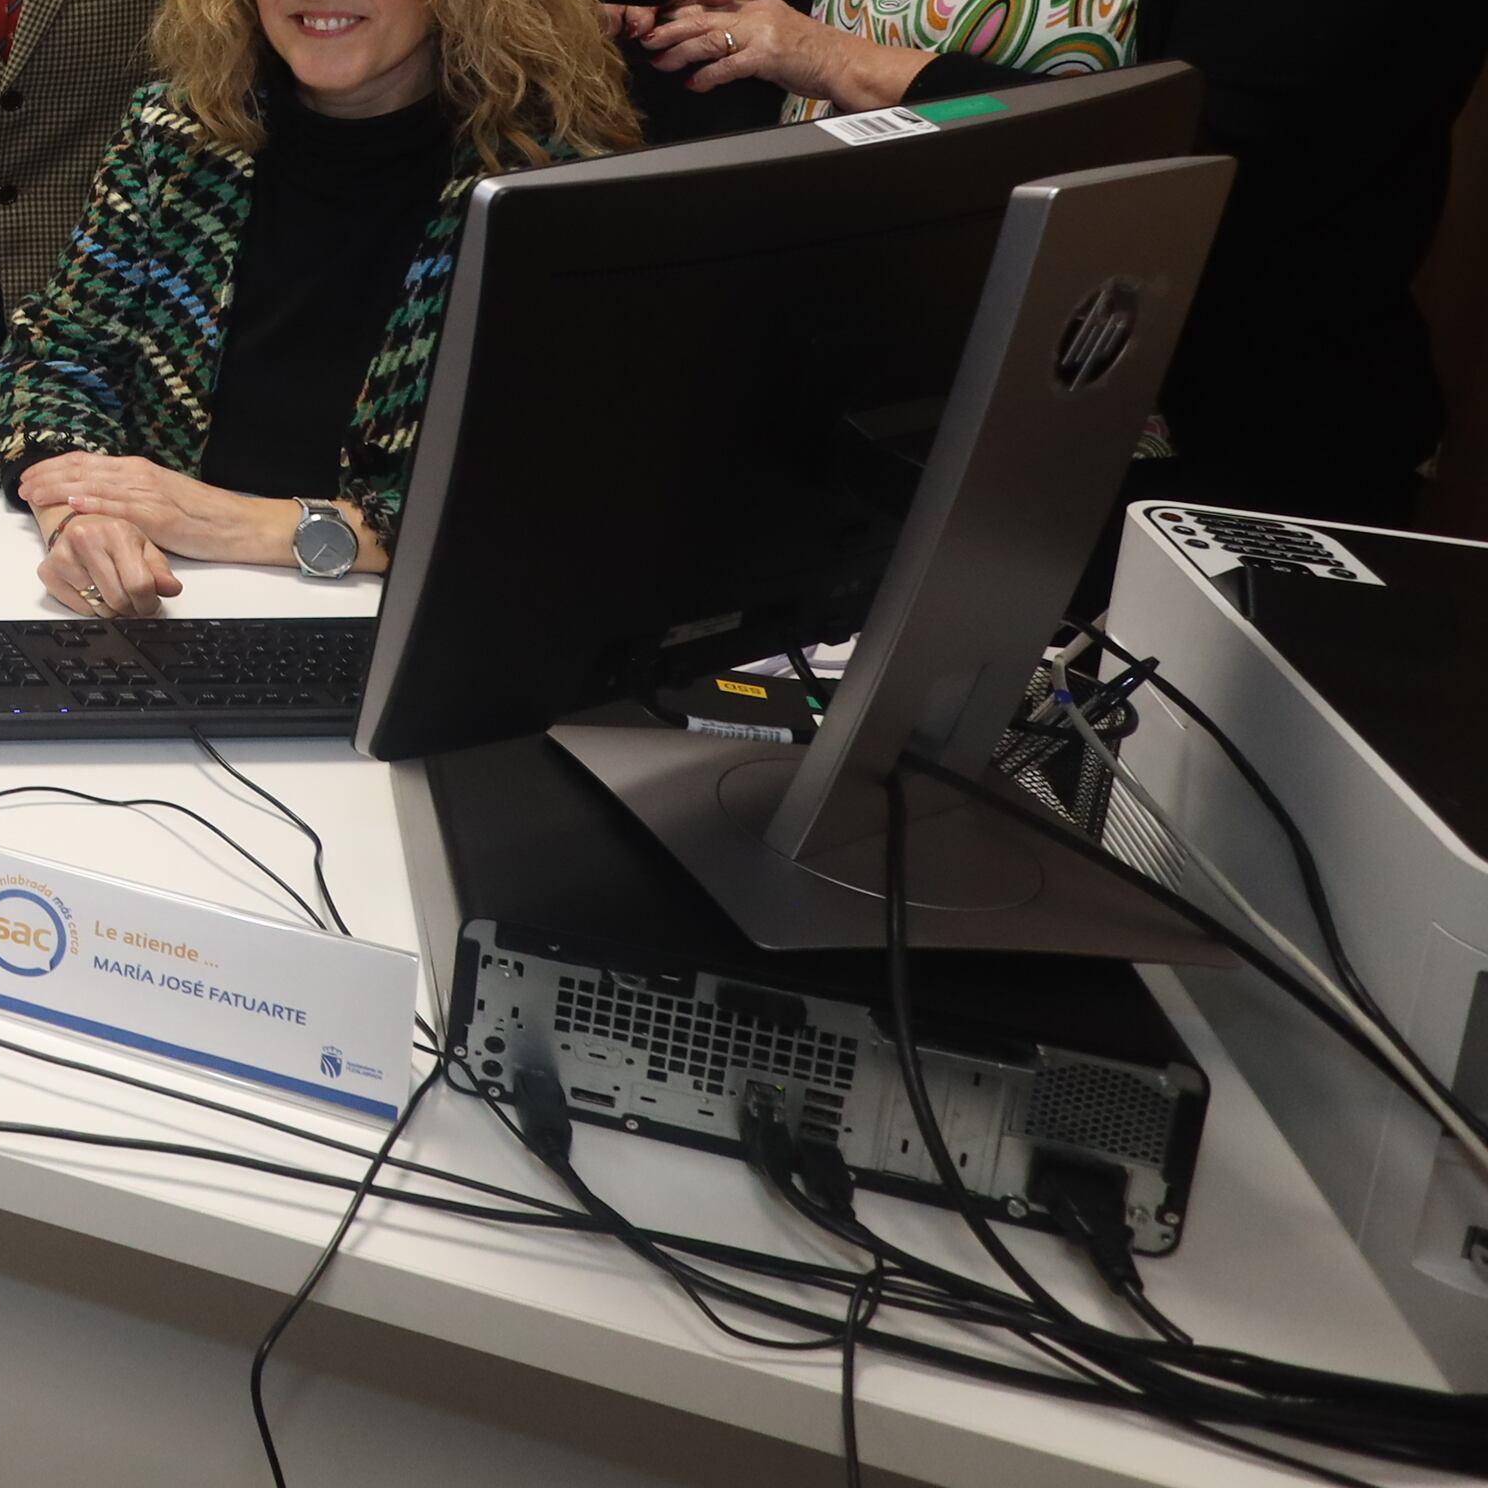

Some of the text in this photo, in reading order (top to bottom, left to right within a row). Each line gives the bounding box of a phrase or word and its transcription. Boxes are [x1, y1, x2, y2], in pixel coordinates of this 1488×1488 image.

[52, 896, 74, 920] más
[68, 921, 80, 956] cerca
[94, 920, 118, 940] Le
[123, 931, 200, 963] atiende
[93, 955, 308, 1026] MARÍA JOSÉ FATUARTE
